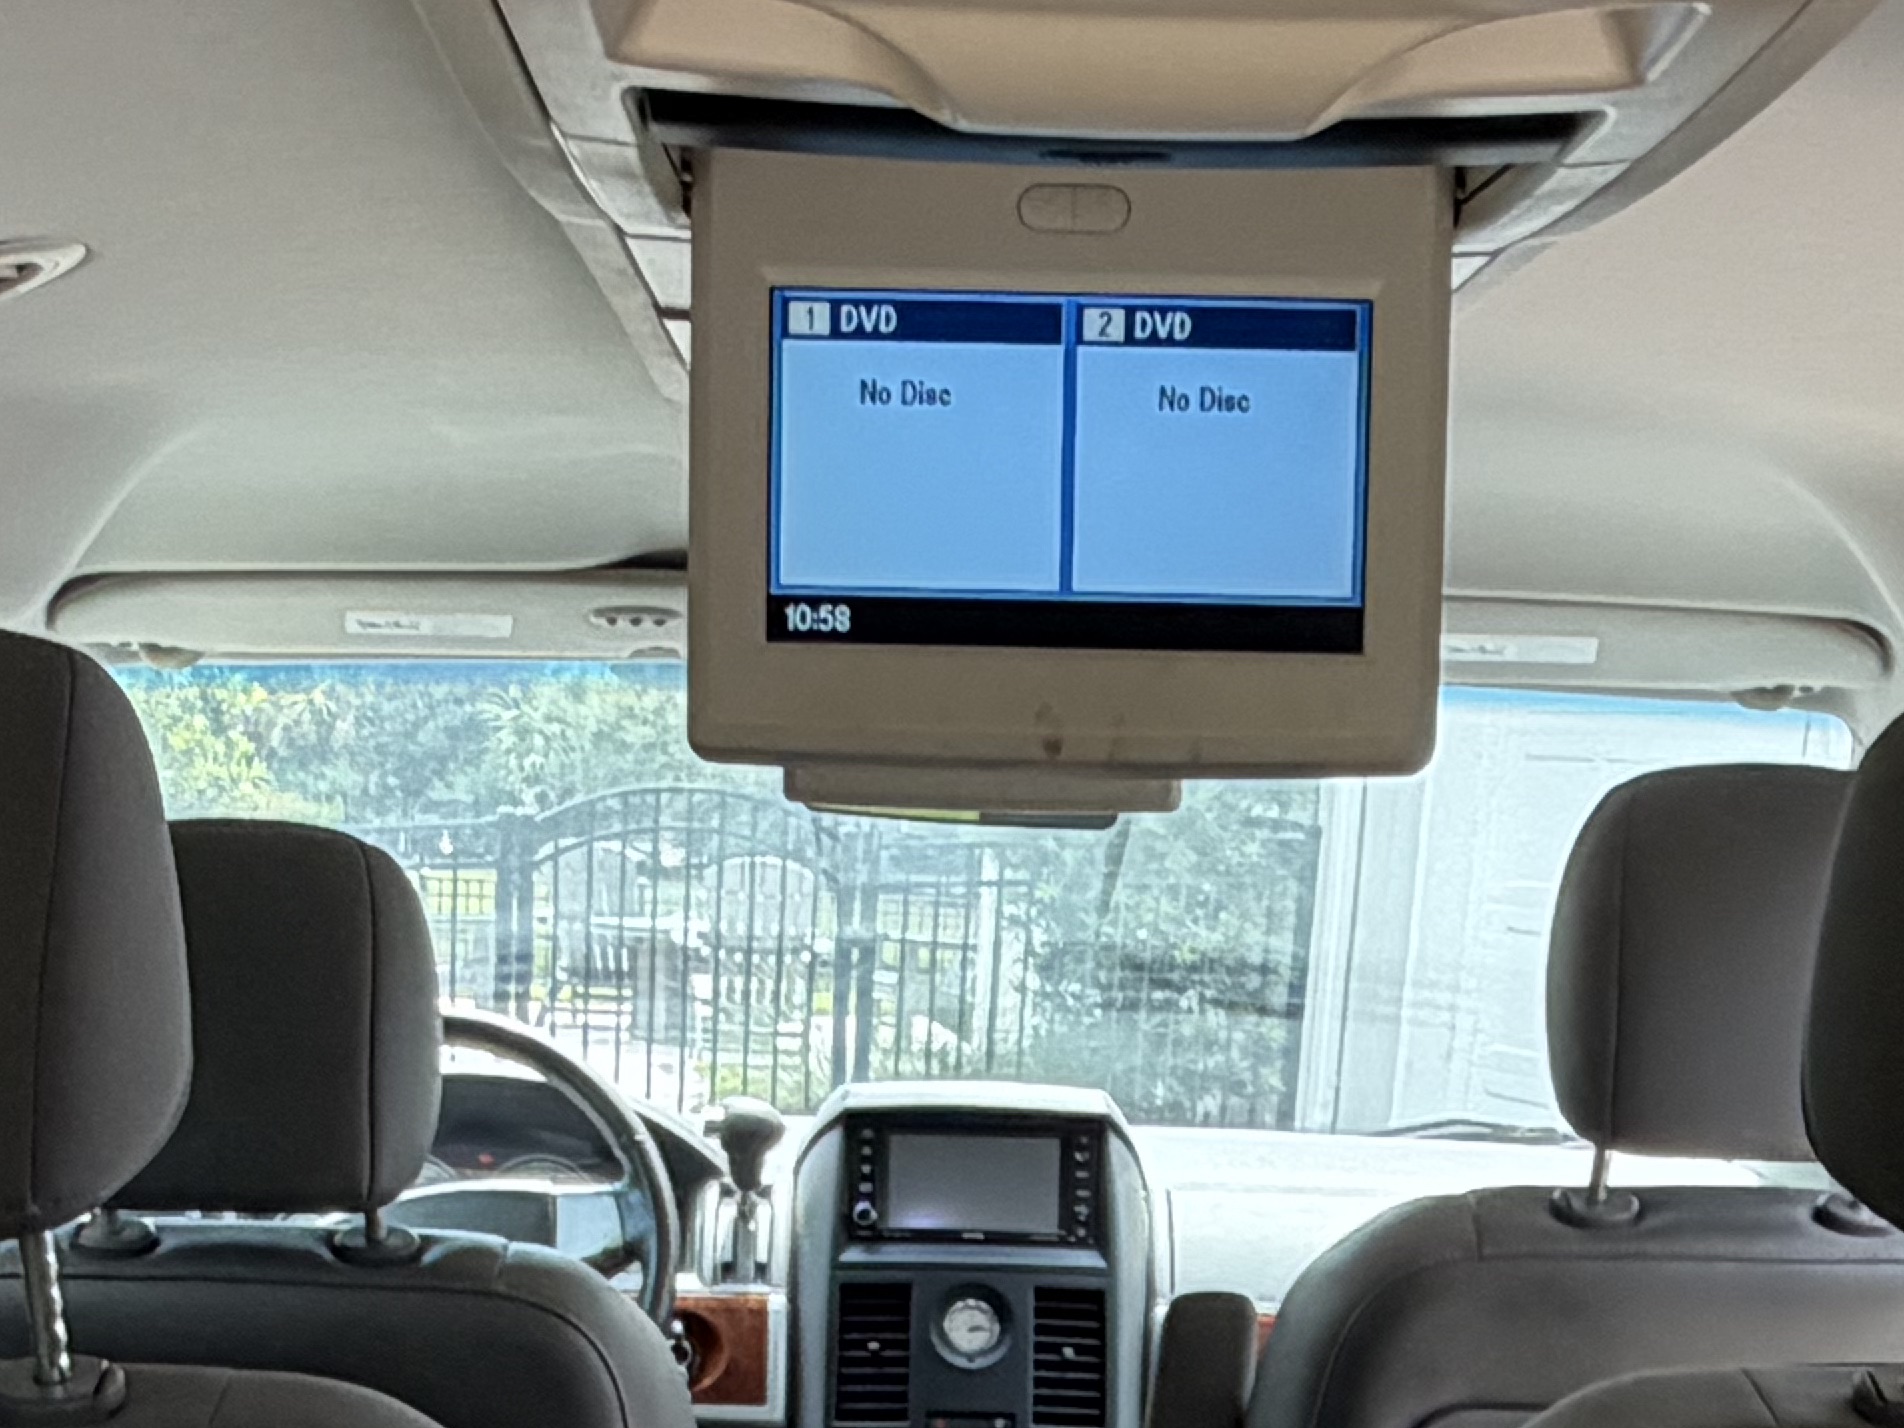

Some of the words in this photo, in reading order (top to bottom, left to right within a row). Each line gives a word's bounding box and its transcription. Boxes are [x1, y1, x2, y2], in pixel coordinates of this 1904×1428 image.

[839, 304, 897, 334] DVD
[1097, 310, 1114, 339] 2
[1133, 310, 1192, 340] DVD
[859, 378, 891, 407] No
[899, 378, 953, 408] Disc
[1158, 384, 1190, 414] No
[1199, 385, 1252, 415] Disc
[784, 602, 851, 633] 10:58
